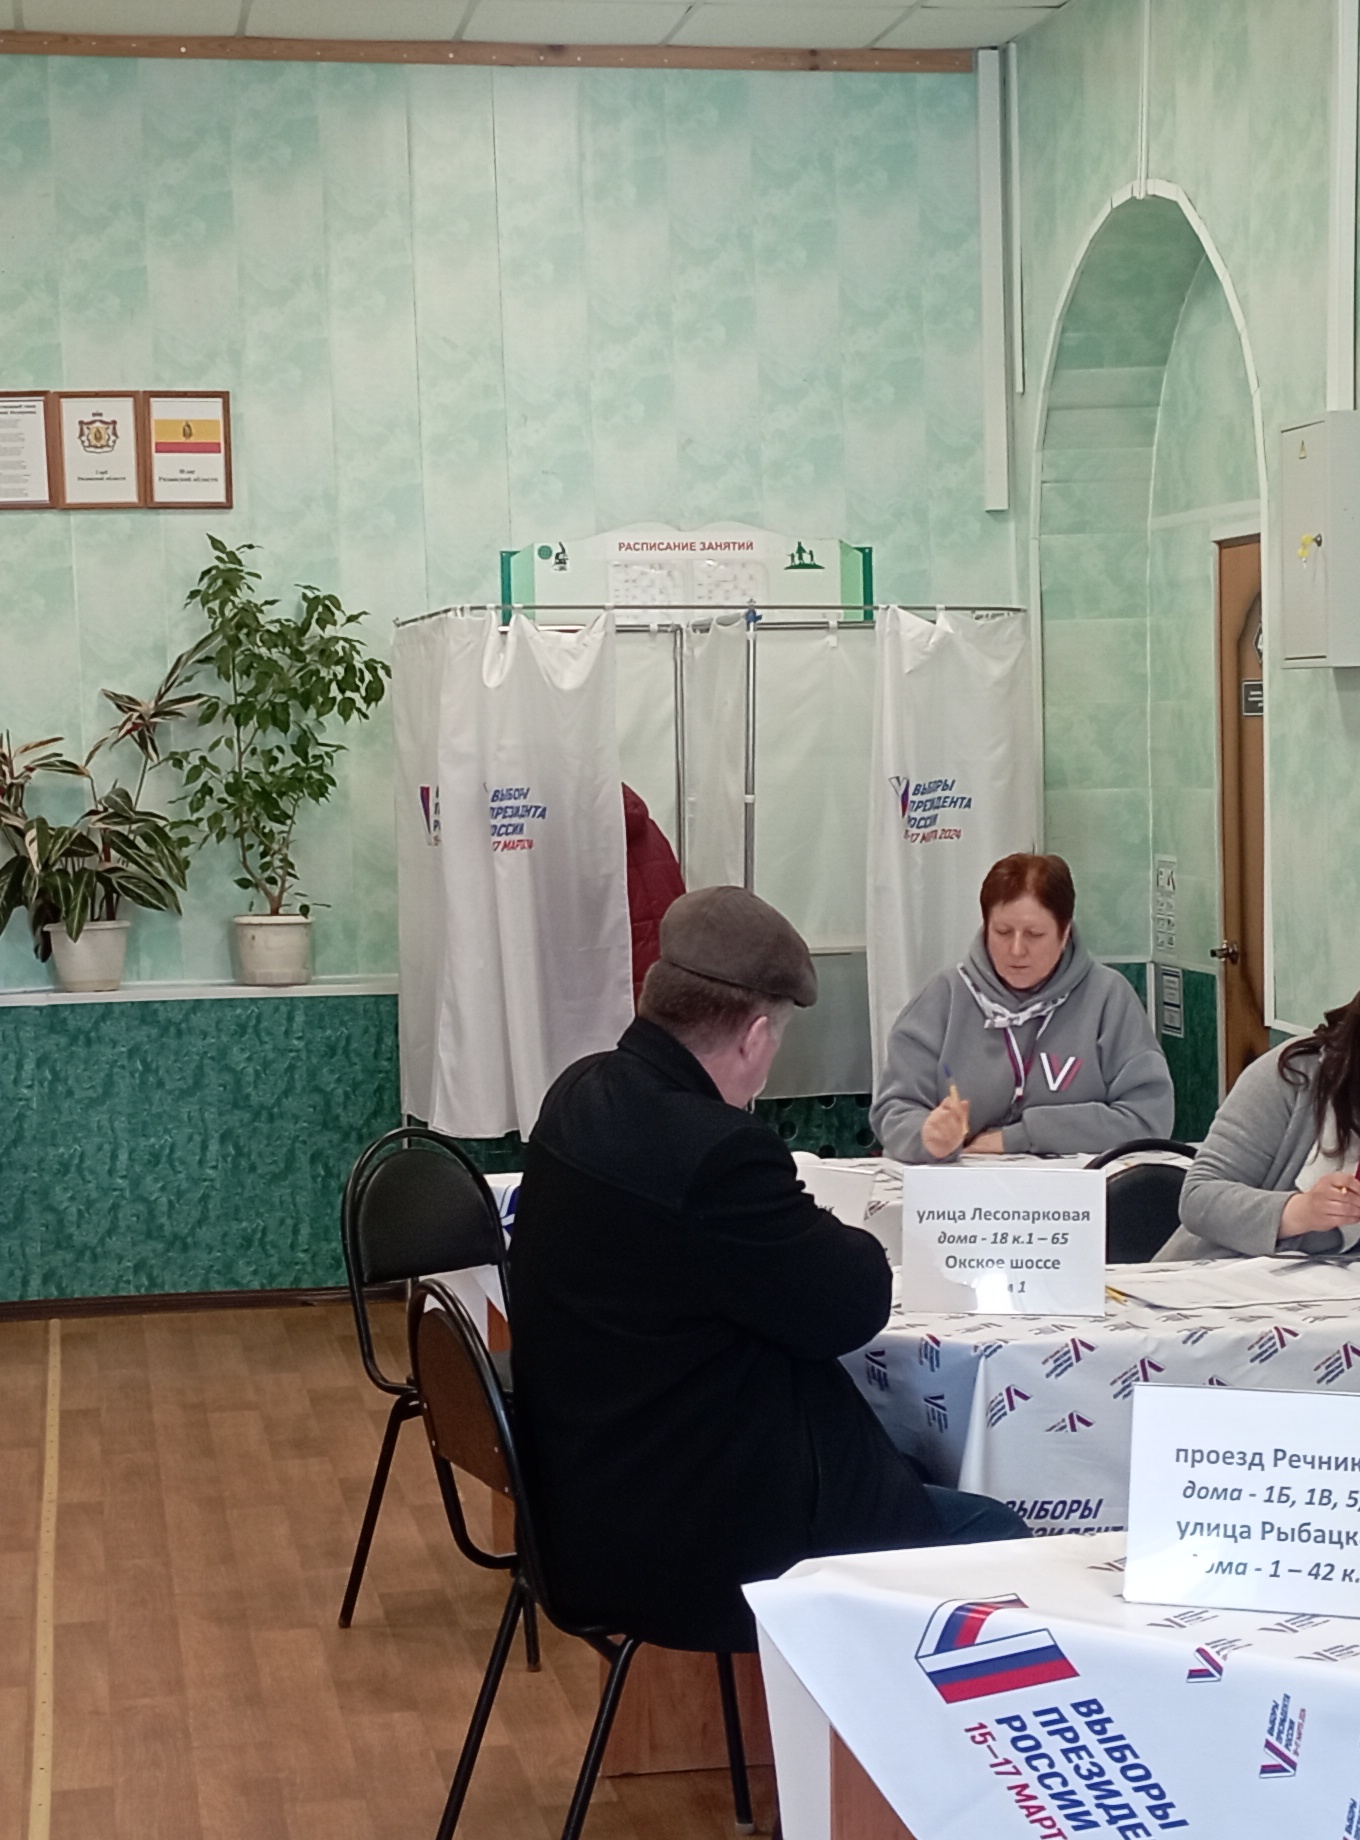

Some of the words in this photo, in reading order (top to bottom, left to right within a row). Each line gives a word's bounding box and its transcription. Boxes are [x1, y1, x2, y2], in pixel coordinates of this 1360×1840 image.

[618, 541, 697, 552] РАСПИСАНИЕ
[699, 540, 754, 552] ЗАНЯТИЙ
[916, 1209, 966, 1224] улица
[970, 1207, 1091, 1224] Лесопарковая
[937, 1231, 977, 1245] дома
[990, 1232, 1008, 1244] 18
[1012, 1232, 1034, 1245] к.1
[1051, 1232, 1069, 1245] 65
[945, 1255, 1005, 1270] Окское
[1009, 1258, 1061, 1270] шоссе
[1017, 1281, 1026, 1293] 1
[1175, 1448, 1265, 1472] проезд
[1182, 1480, 1243, 1502] дома
[1263, 1485, 1296, 1508] 1Б,
[1304, 1488, 1338, 1510] 1В,
[1176, 1520, 1252, 1543] улица
[1269, 1560, 1281, 1578] 1
[1307, 1563, 1335, 1582] 42
[995, 1714, 1101, 1832] РОССИИ
[1032, 1706, 1153, 1840] ПРЕЗИДЕ
[1070, 1698, 1189, 1830] ВЫБОРЫ
[1007, 1783, 1068, 1840] МАРТ
